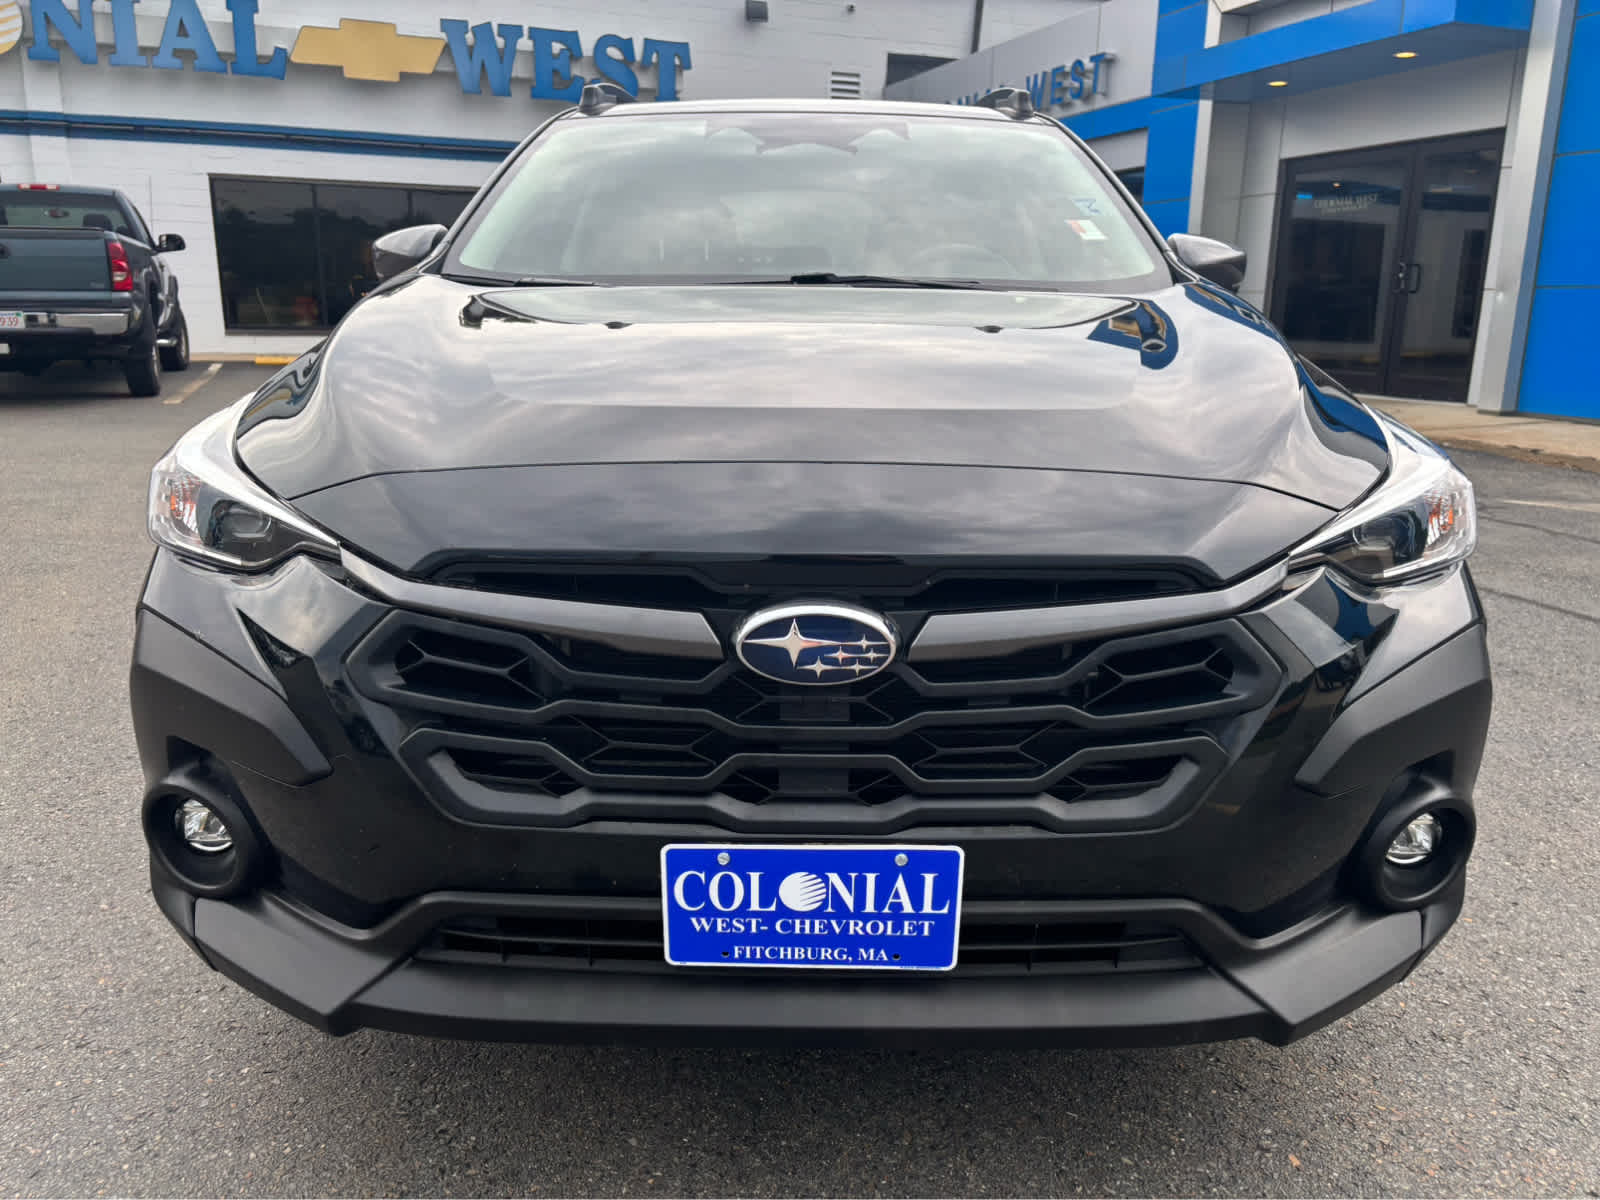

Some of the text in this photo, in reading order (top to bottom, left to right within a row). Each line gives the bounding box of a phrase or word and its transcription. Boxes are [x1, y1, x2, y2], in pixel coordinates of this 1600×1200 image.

[440, 18, 692, 104] WEST
[1026, 52, 1111, 109] WEST
[673, 870, 950, 914] COLONIAL
[690, 917, 935, 936] WEST- CHEVROLET
[733, 945, 889, 961] FITCHBURG, MA
